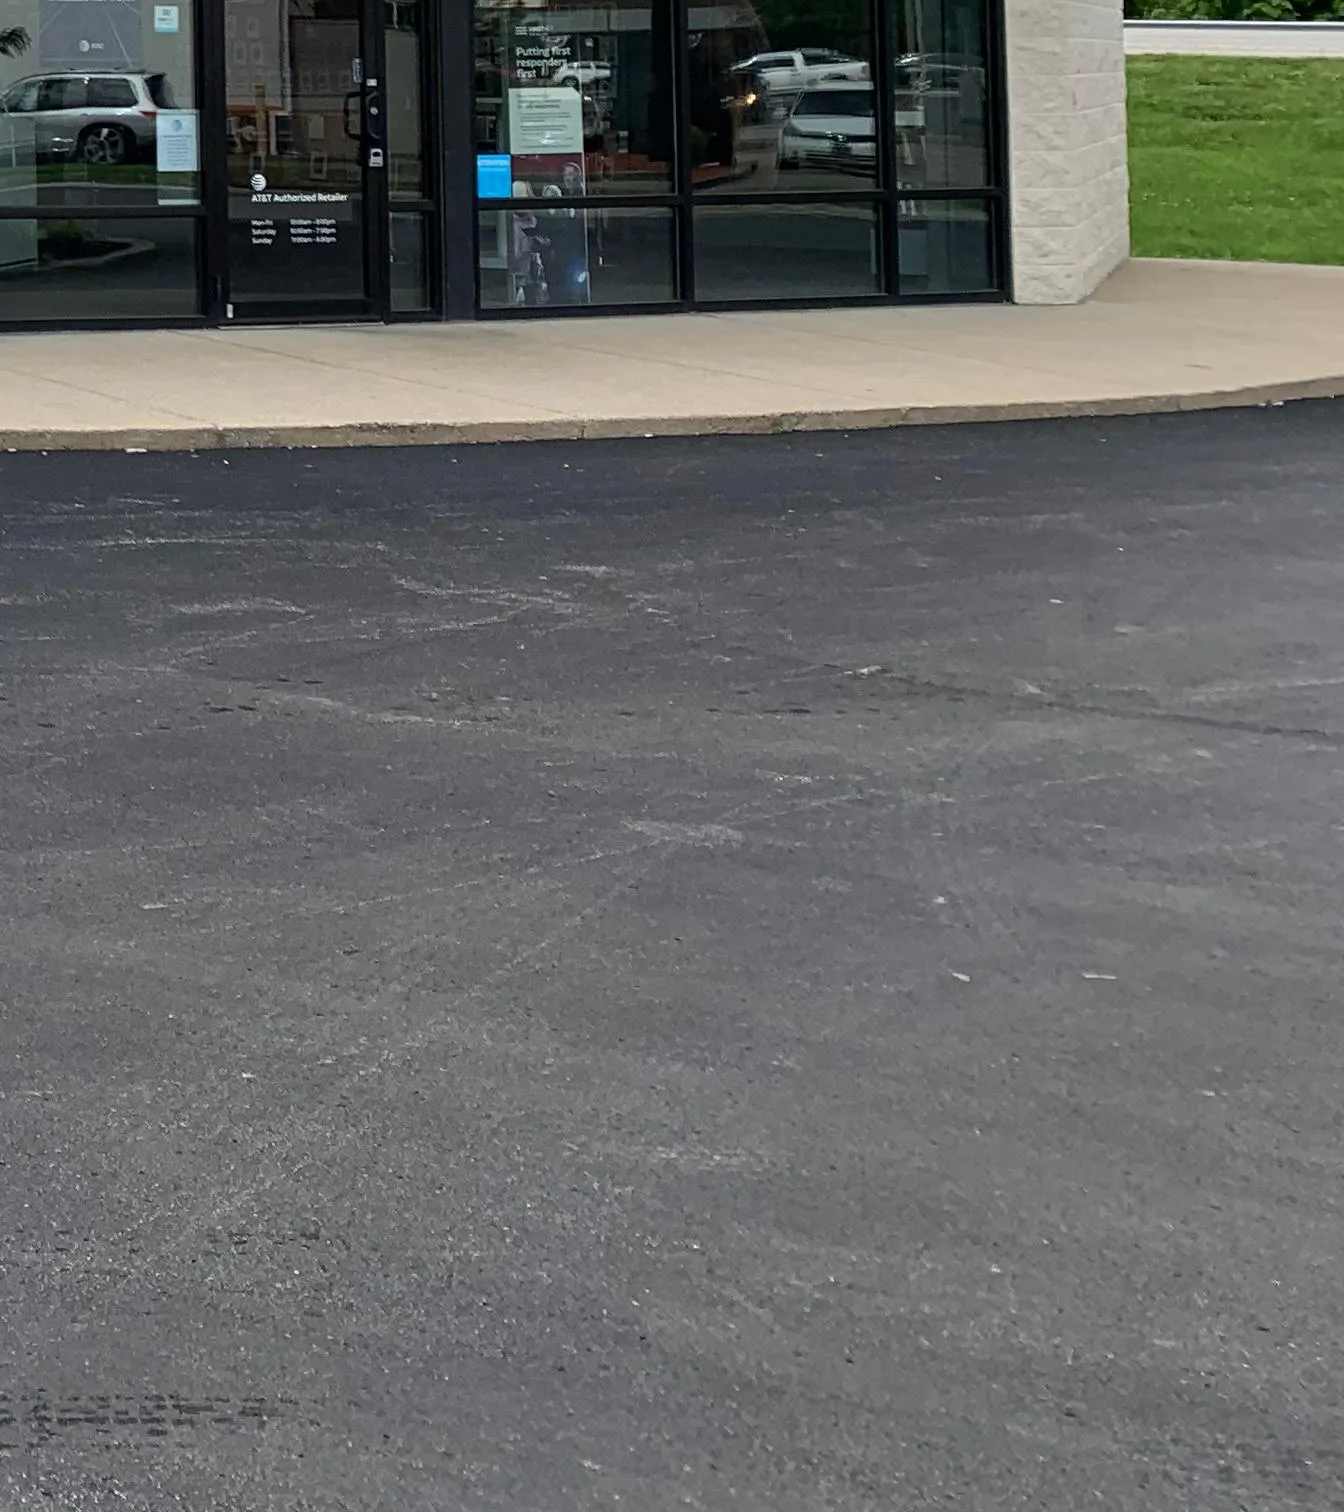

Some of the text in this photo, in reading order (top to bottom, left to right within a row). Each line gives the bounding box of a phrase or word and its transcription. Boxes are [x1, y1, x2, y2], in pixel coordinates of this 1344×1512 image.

[516, 46, 571, 57] Putting first
[516, 58, 568, 68] responders
[516, 69, 537, 78] first
[251, 193, 348, 202] AT&T Authorized Retailer
